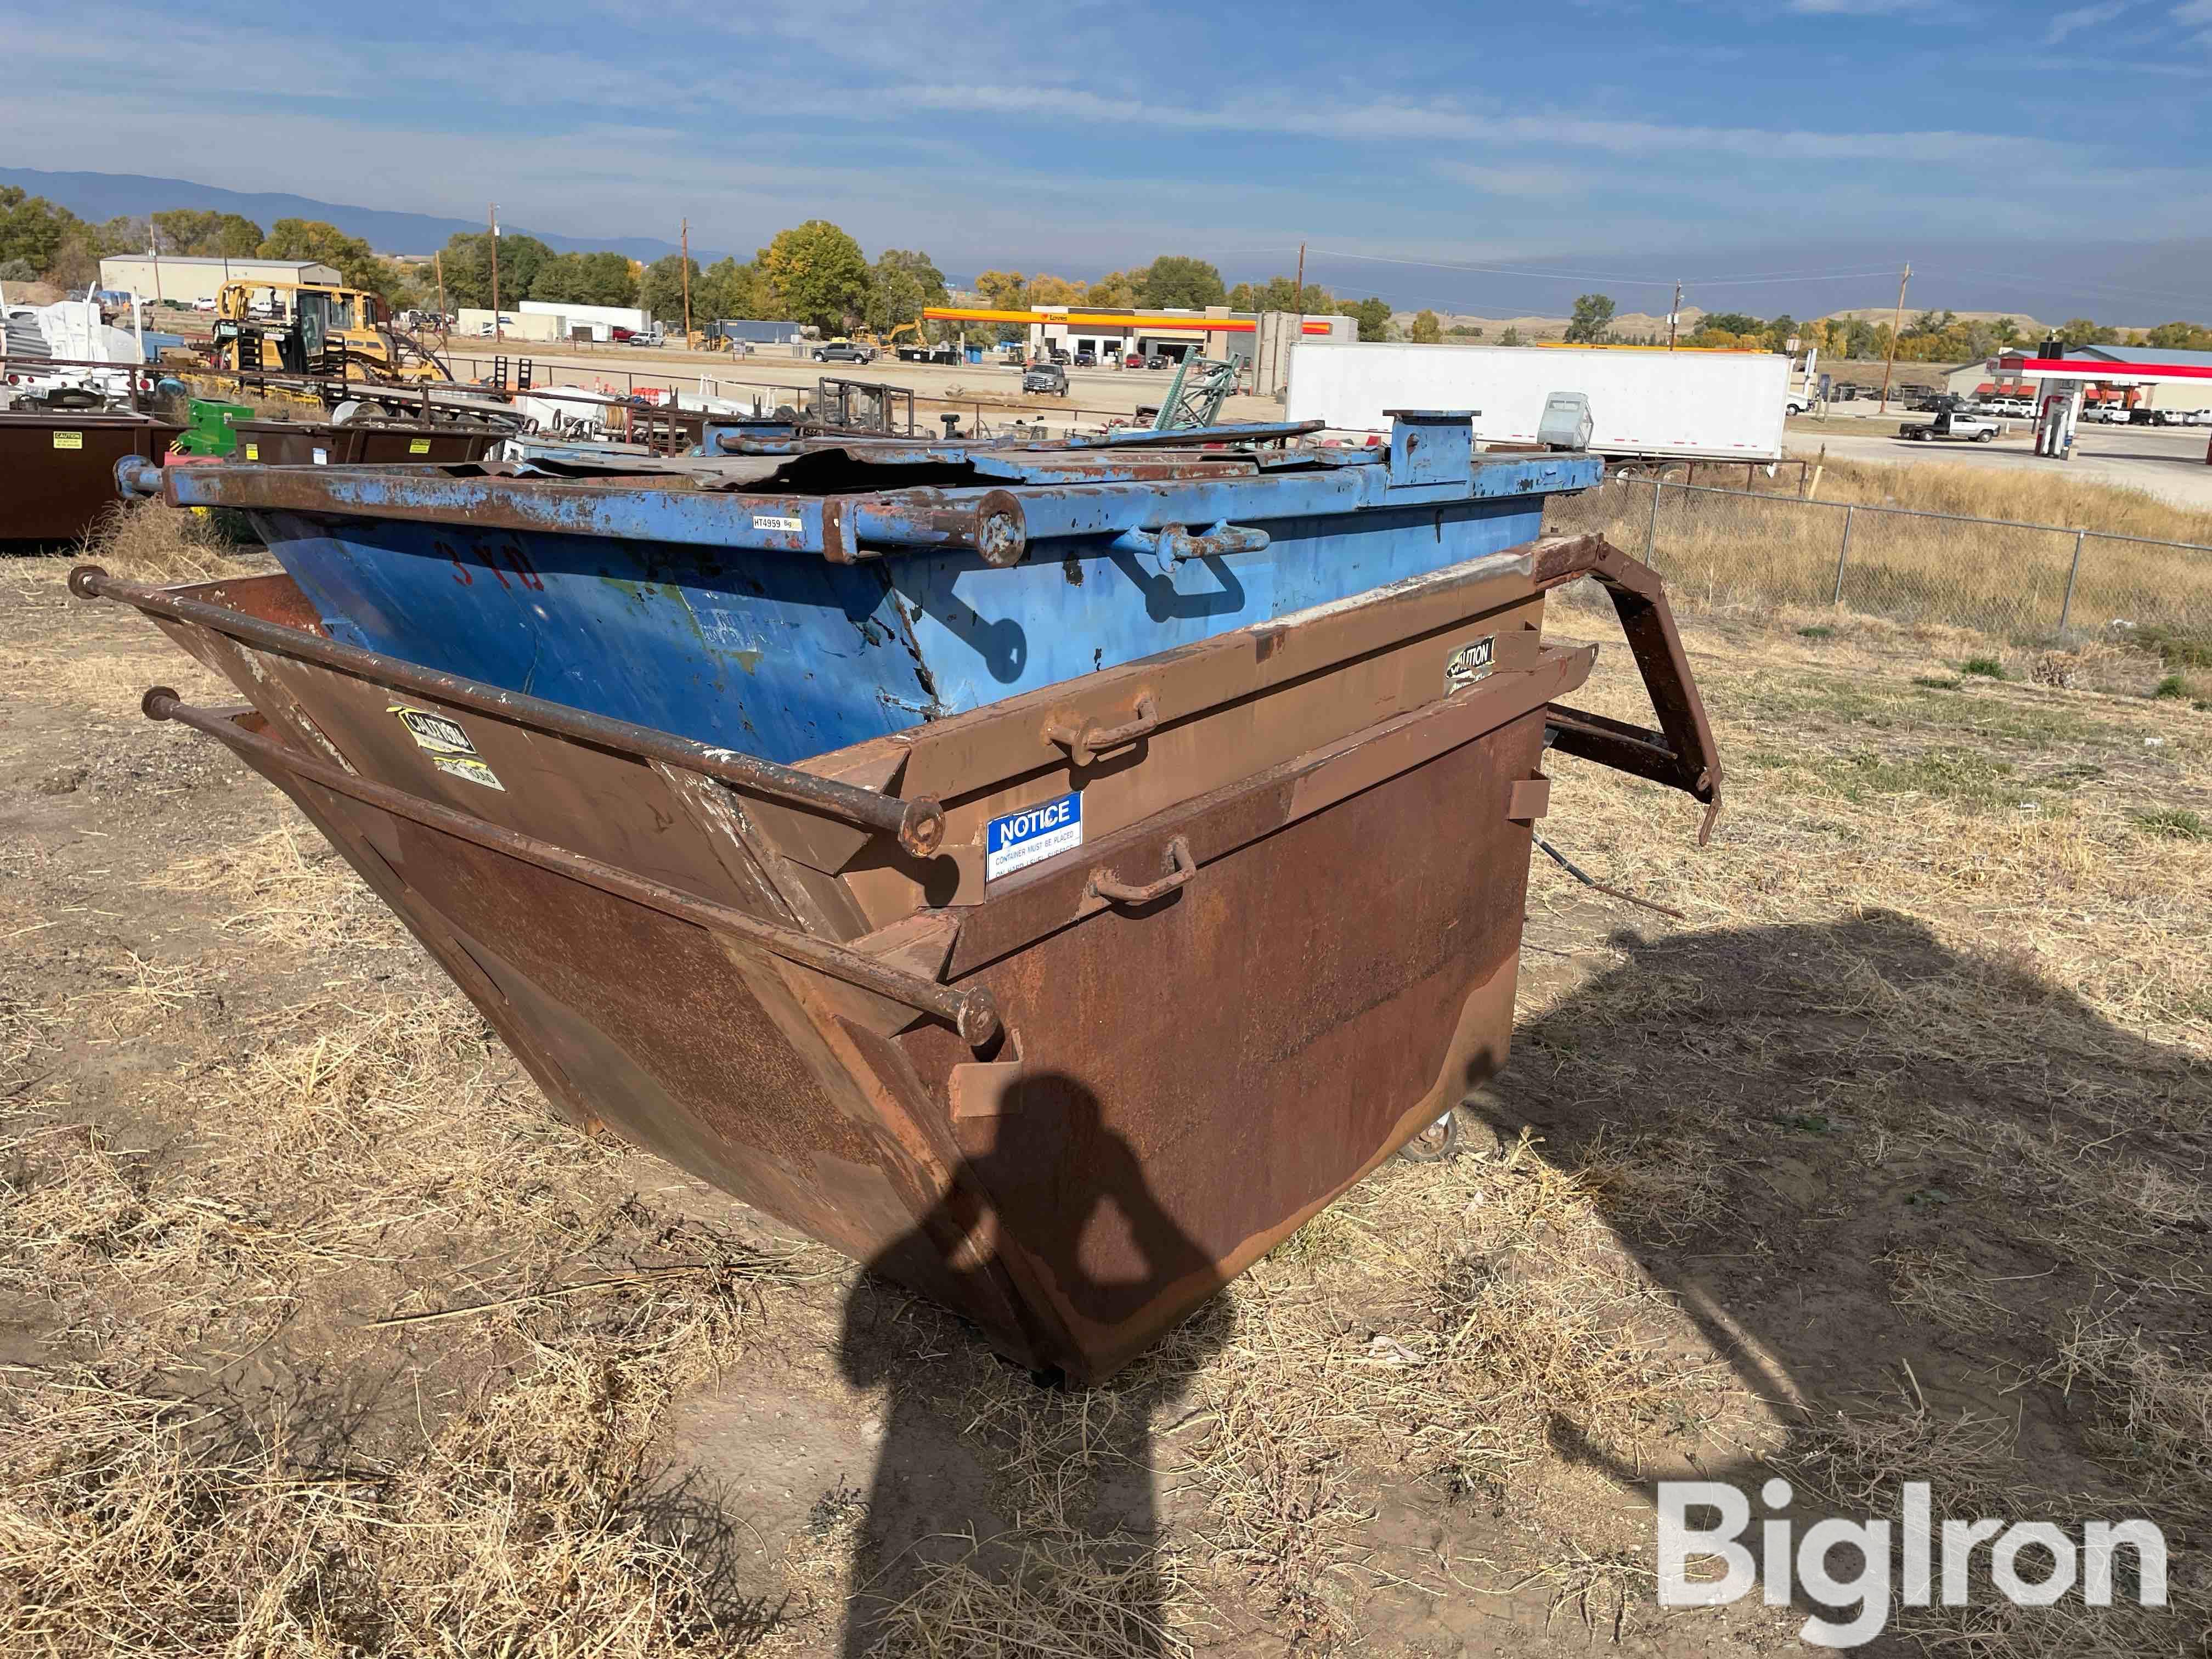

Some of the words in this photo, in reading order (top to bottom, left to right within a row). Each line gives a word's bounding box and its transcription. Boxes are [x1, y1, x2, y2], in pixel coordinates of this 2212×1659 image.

[754, 518, 780, 528] HT4959
[405, 713, 469, 748] CAUTION
[1000, 800, 1070, 843] NOTICE
[996, 848, 1026, 865] CONTAINER
[1028, 842, 1042, 853] MUST
[1045, 838, 1052, 847] BE
[1054, 831, 1074, 843] PLACED
